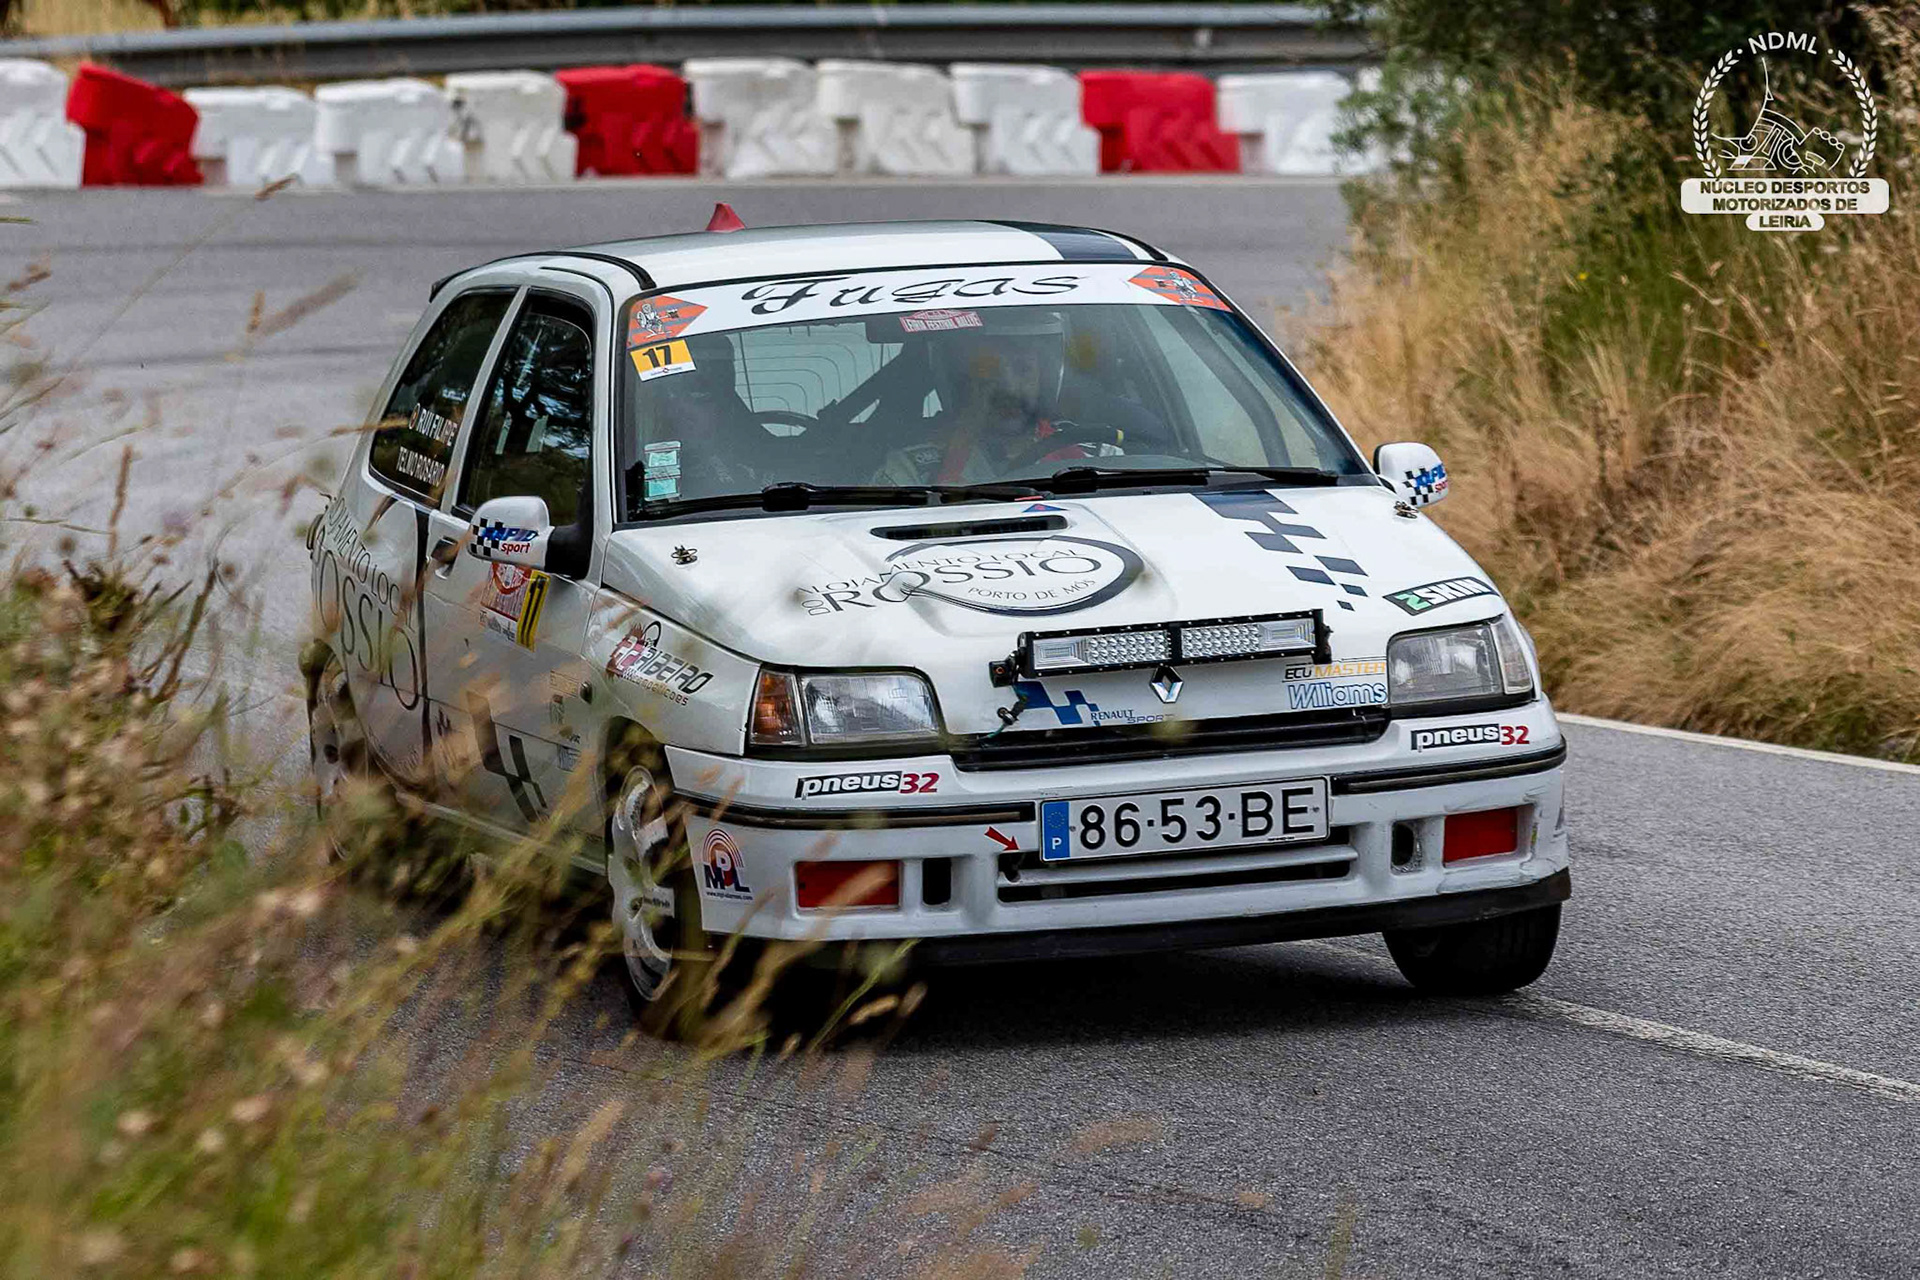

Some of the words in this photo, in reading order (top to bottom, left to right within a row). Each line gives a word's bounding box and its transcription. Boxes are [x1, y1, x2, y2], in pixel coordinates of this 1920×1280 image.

[741, 275, 1083, 315] Fugas
[642, 344, 672, 368] 17
[416, 408, 435, 436] RUI
[501, 542, 531, 555] sport
[990, 549, 1078, 562] LOCAL
[821, 556, 1102, 612] ROSSIO
[968, 586, 1027, 601] PORTO
[1036, 589, 1058, 601] DE
[1091, 709, 1134, 721] RENAULT
[1052, 836, 1062, 850] P
